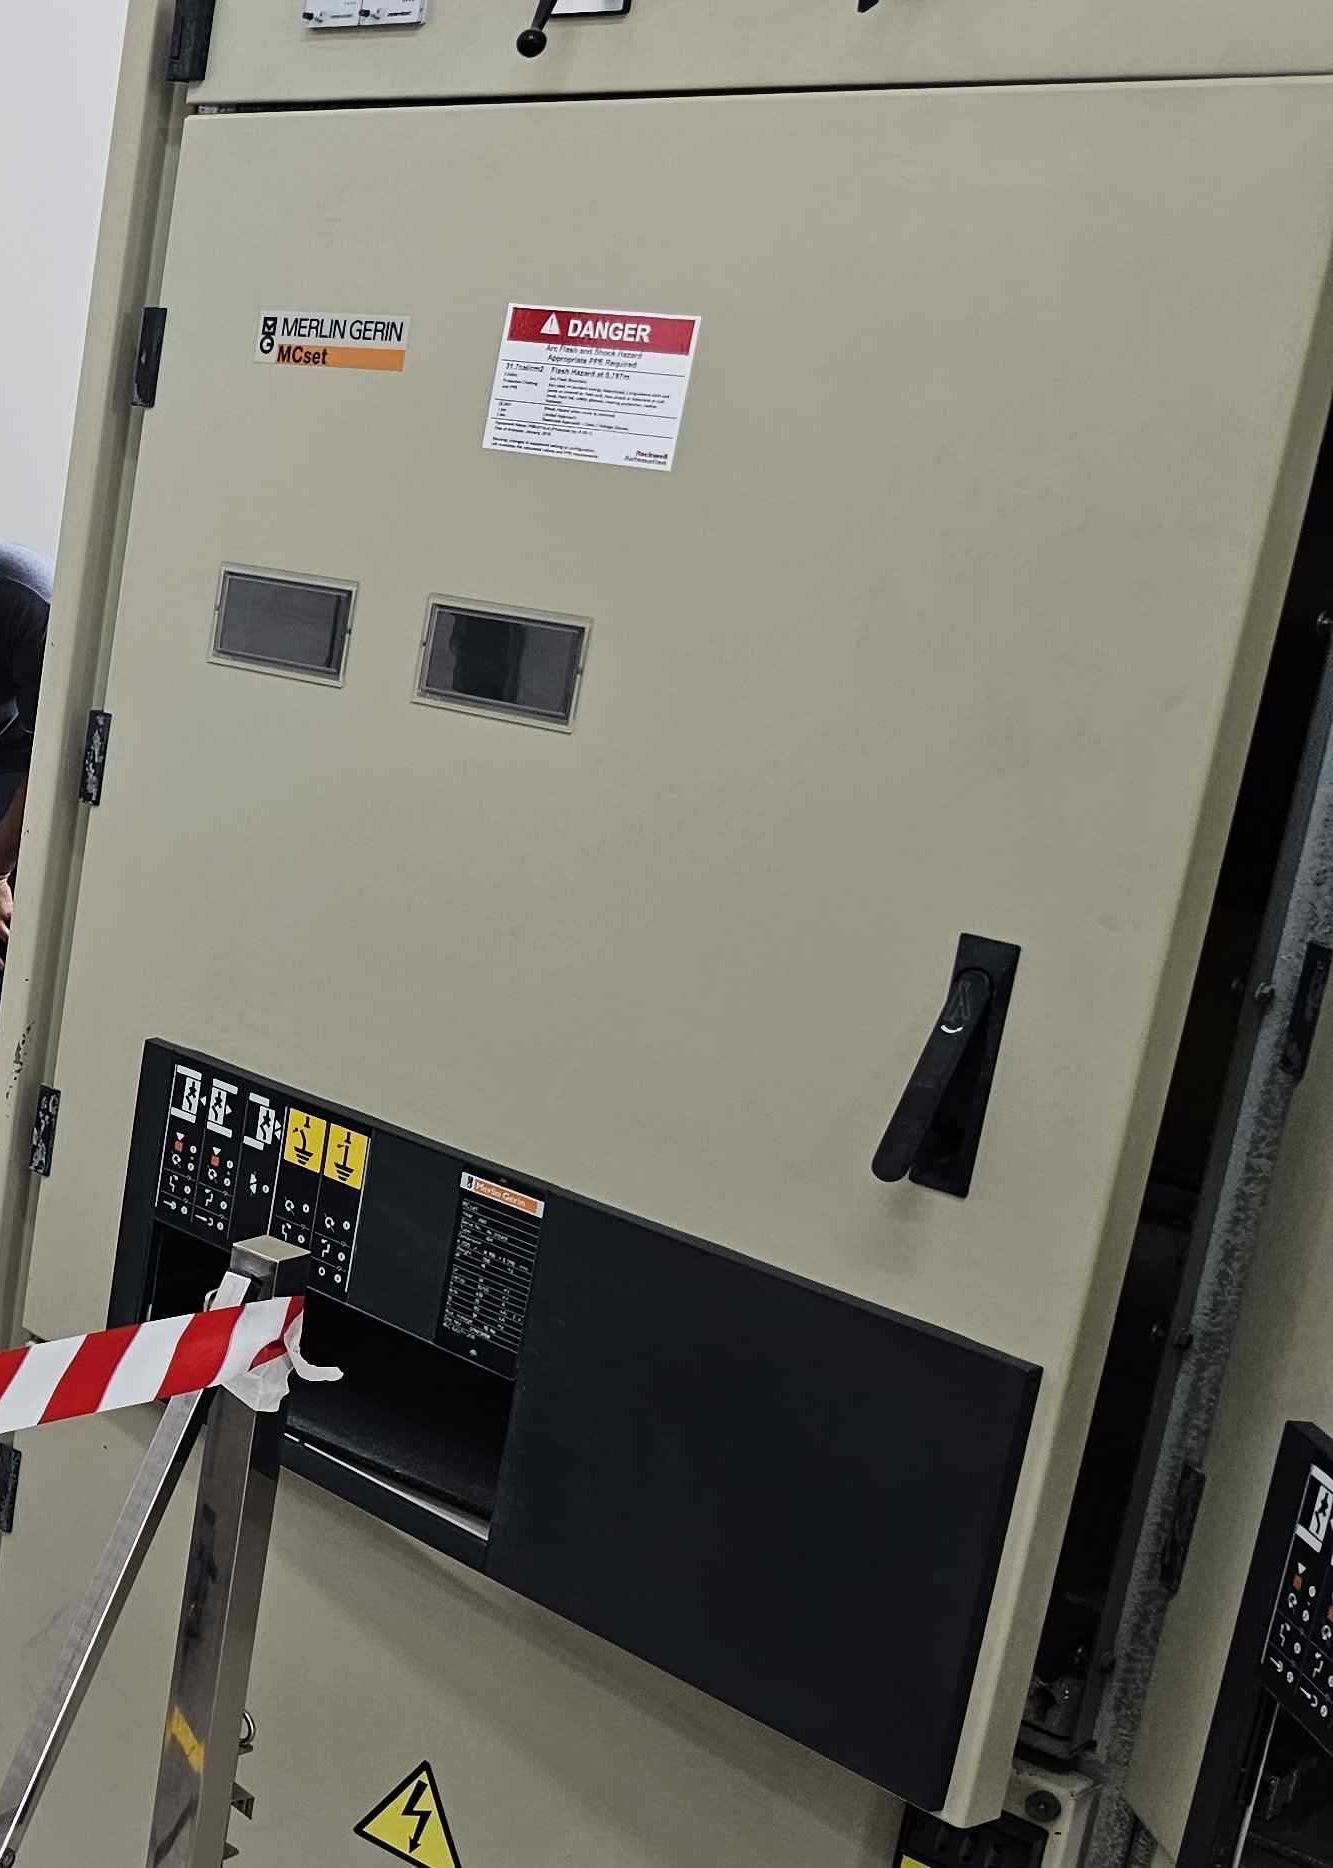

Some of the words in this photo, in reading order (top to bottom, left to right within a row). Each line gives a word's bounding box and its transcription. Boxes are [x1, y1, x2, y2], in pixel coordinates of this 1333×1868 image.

[281, 317, 346, 339] MERLIN
[349, 319, 404, 342] GERIN
[567, 319, 652, 343] DANGER
[276, 345, 328, 365] MCset
